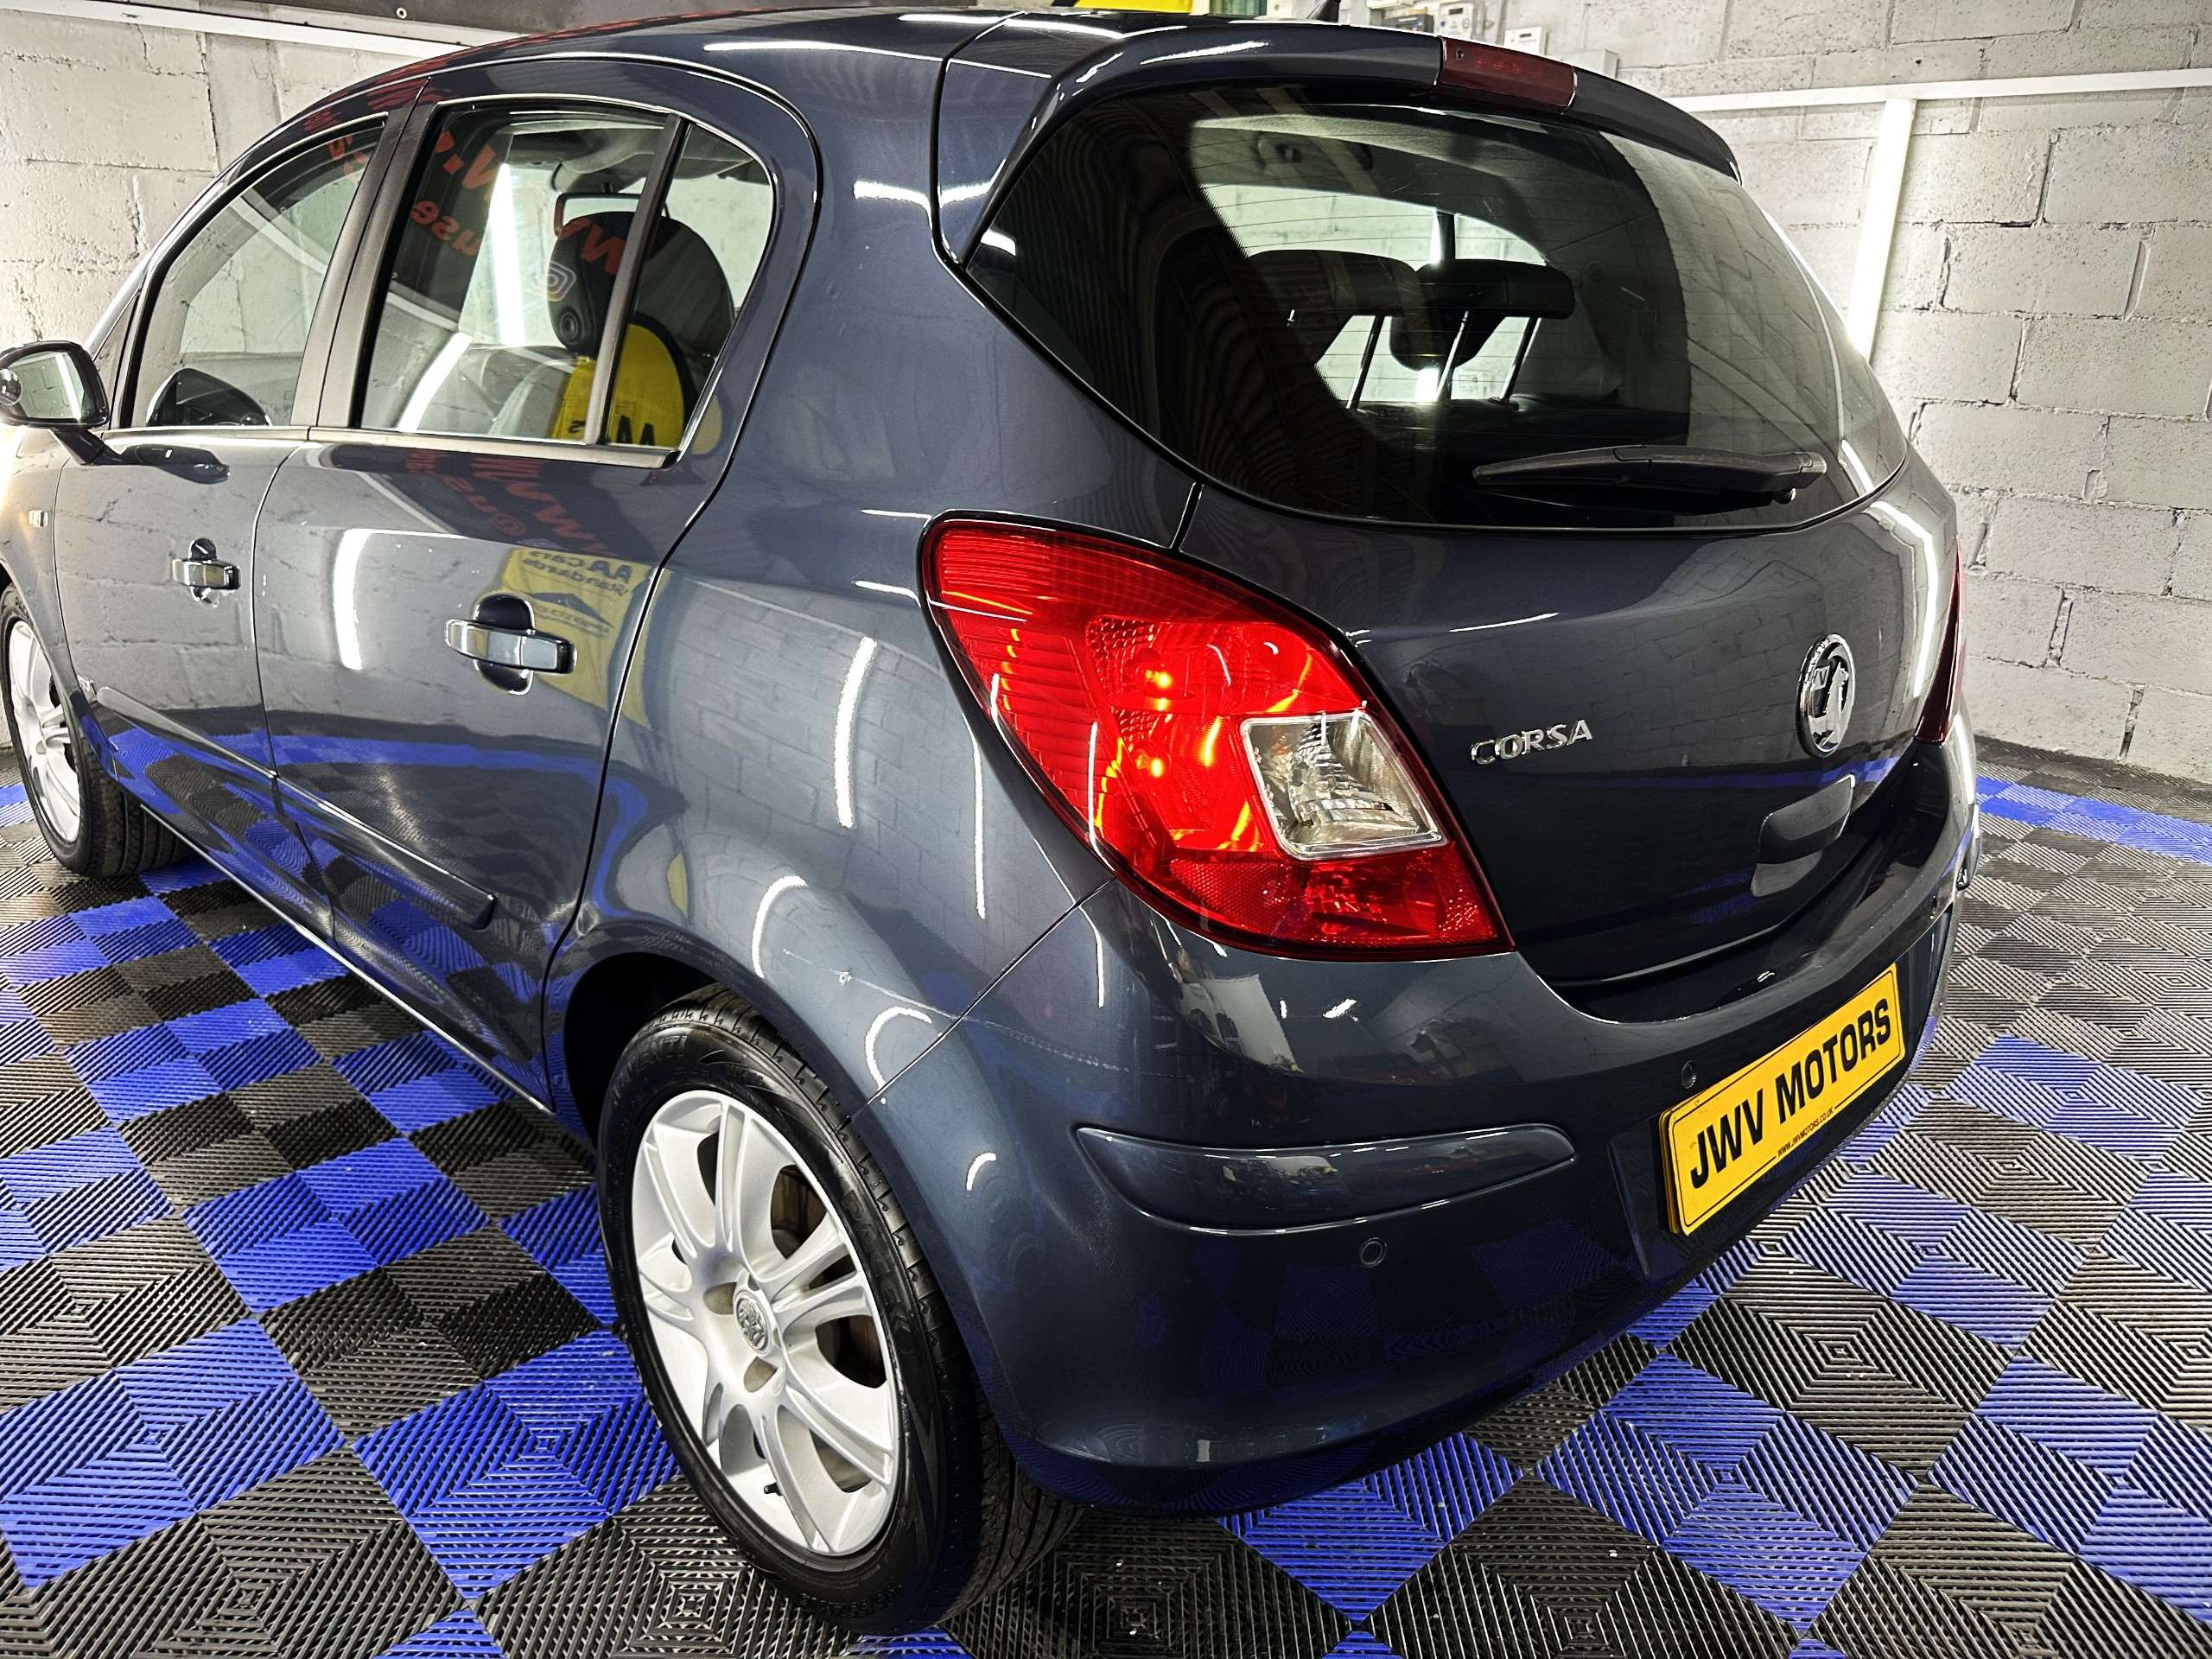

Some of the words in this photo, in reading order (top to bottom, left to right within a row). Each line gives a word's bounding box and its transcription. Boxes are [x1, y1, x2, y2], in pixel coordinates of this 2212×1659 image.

[1471, 719, 1593, 766] CORSA
[1690, 1089, 1764, 1189] JWV
[1775, 998, 1891, 1125] MOTORS
